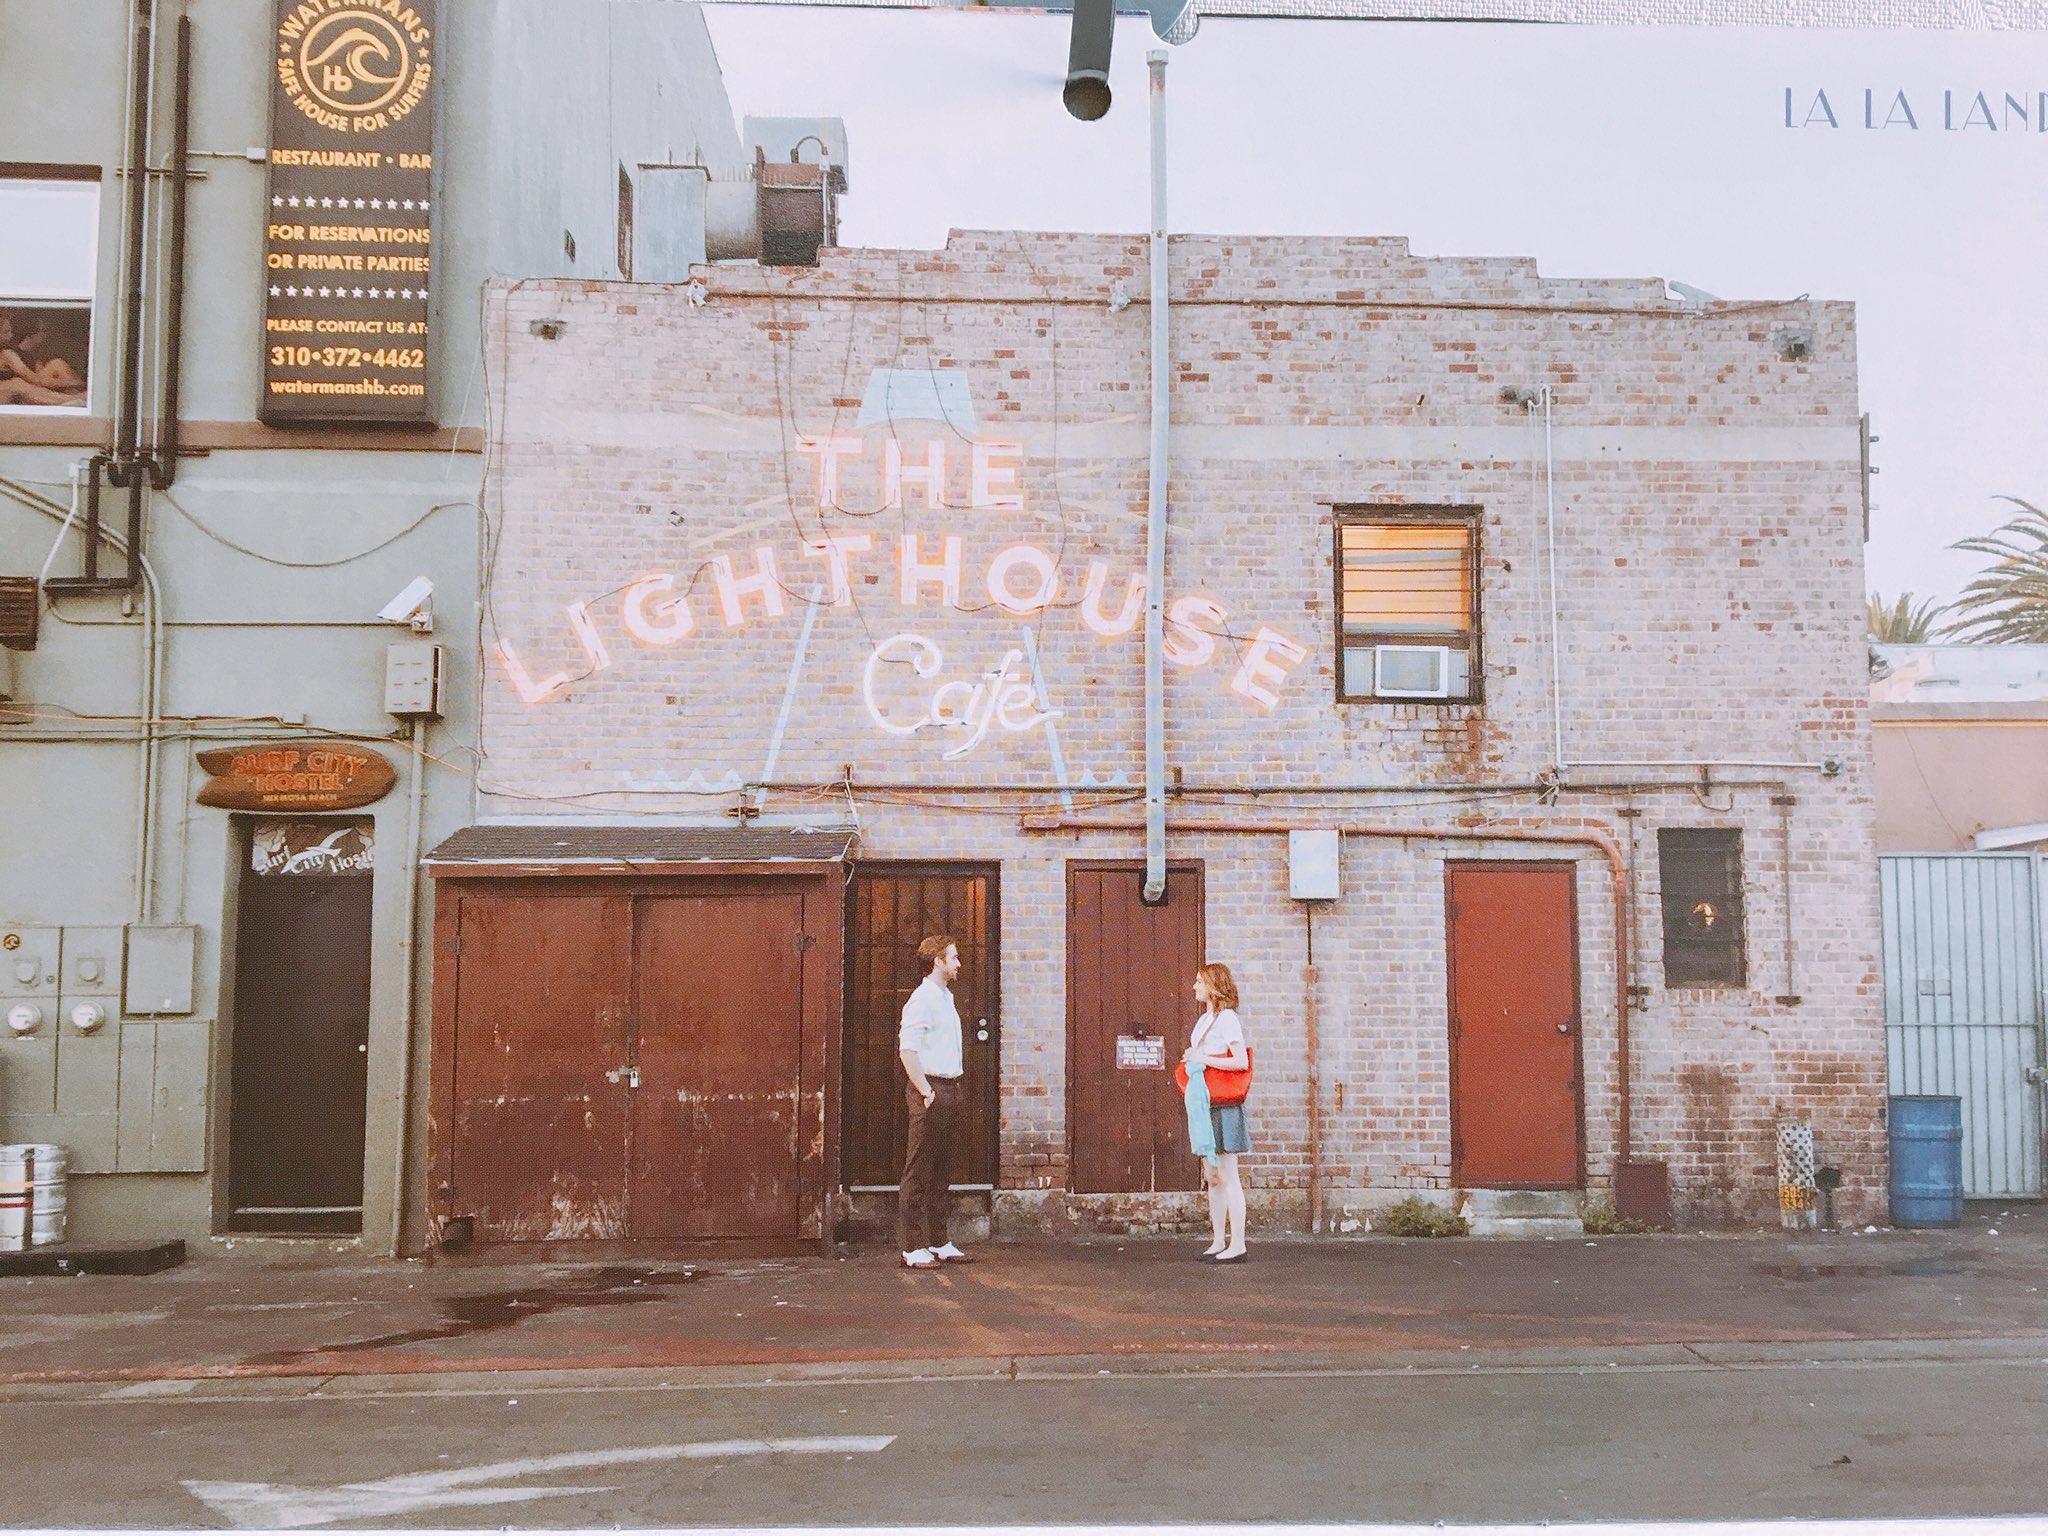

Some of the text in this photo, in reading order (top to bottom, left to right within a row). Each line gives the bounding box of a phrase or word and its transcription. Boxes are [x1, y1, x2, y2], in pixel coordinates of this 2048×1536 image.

[277, 58, 432, 133] SAFE HOUSE FOR SURFERS
[1785, 87, 1839, 129] LA
[1864, 88, 1919, 130] LA
[271, 149, 433, 169] RESTAURANT BAR
[268, 225, 430, 244] FOR RESERVATIONS
[267, 254, 430, 272] OR PRIVATE PARTIES
[266, 319, 313, 332] PLEASE
[316, 320, 383, 334] CONTACT
[386, 321, 404, 334] US
[270, 378, 425, 396] watermanshb.com
[796, 435, 1024, 510] THE
[494, 534, 1308, 711] LIGHTHOUSE
[863, 633, 1064, 761] Cafe
[231, 751, 368, 776] SURF CITY
[255, 773, 344, 791] HOSTEL
